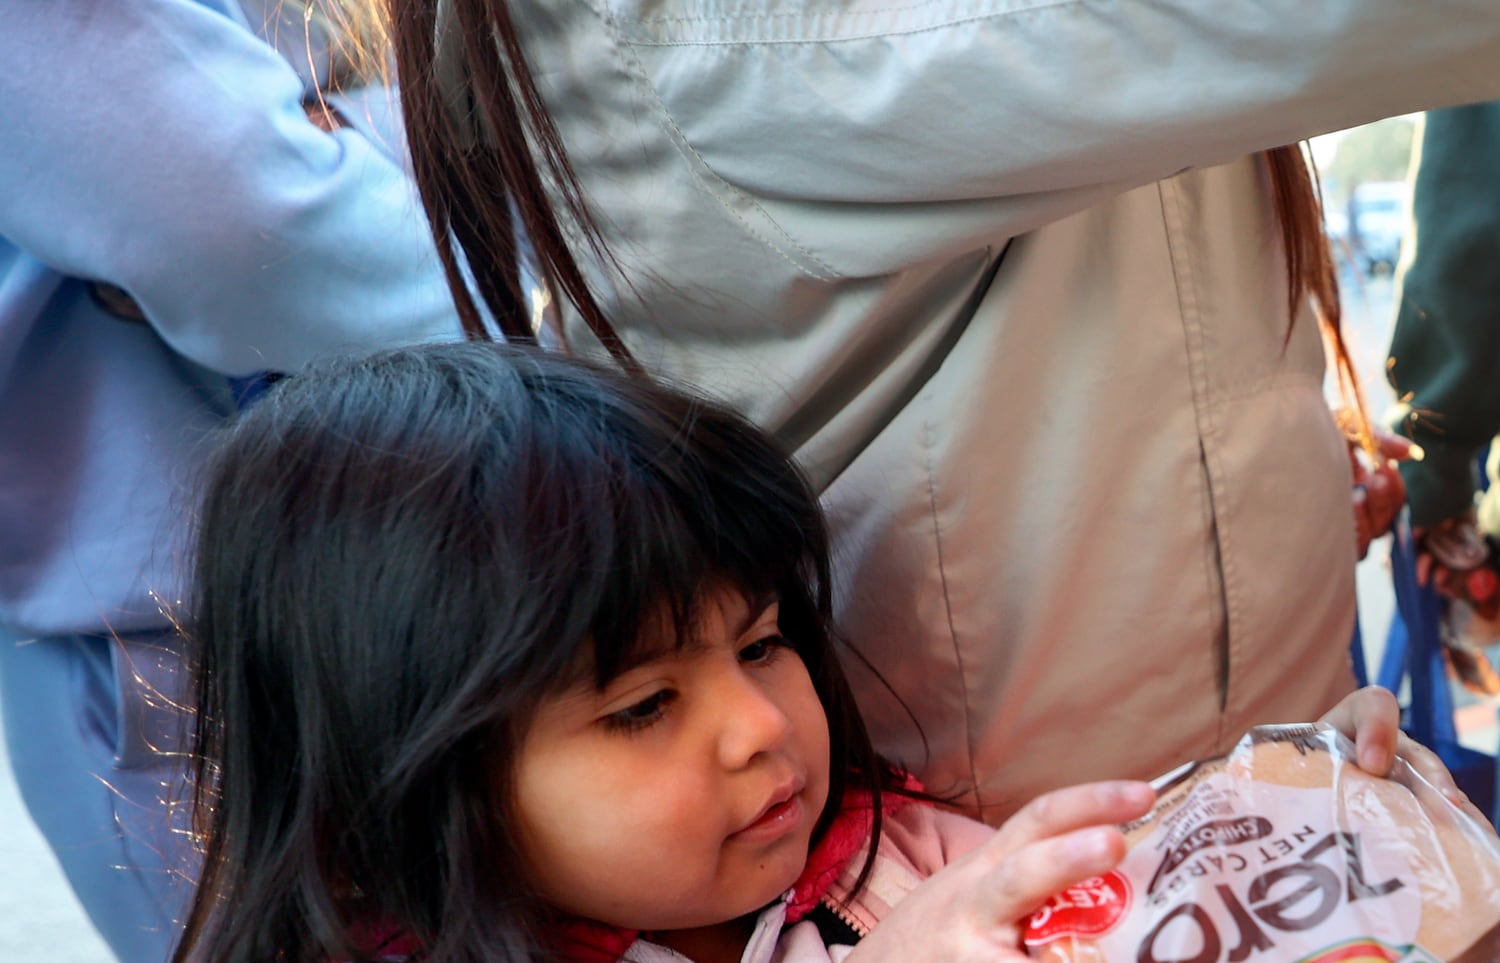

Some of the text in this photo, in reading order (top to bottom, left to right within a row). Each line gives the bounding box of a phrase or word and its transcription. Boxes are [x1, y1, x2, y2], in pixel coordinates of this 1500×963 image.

[1258, 825, 1316, 864] NET
[1153, 852, 1247, 905] CARBS
[1030, 883, 1116, 930] KETO
